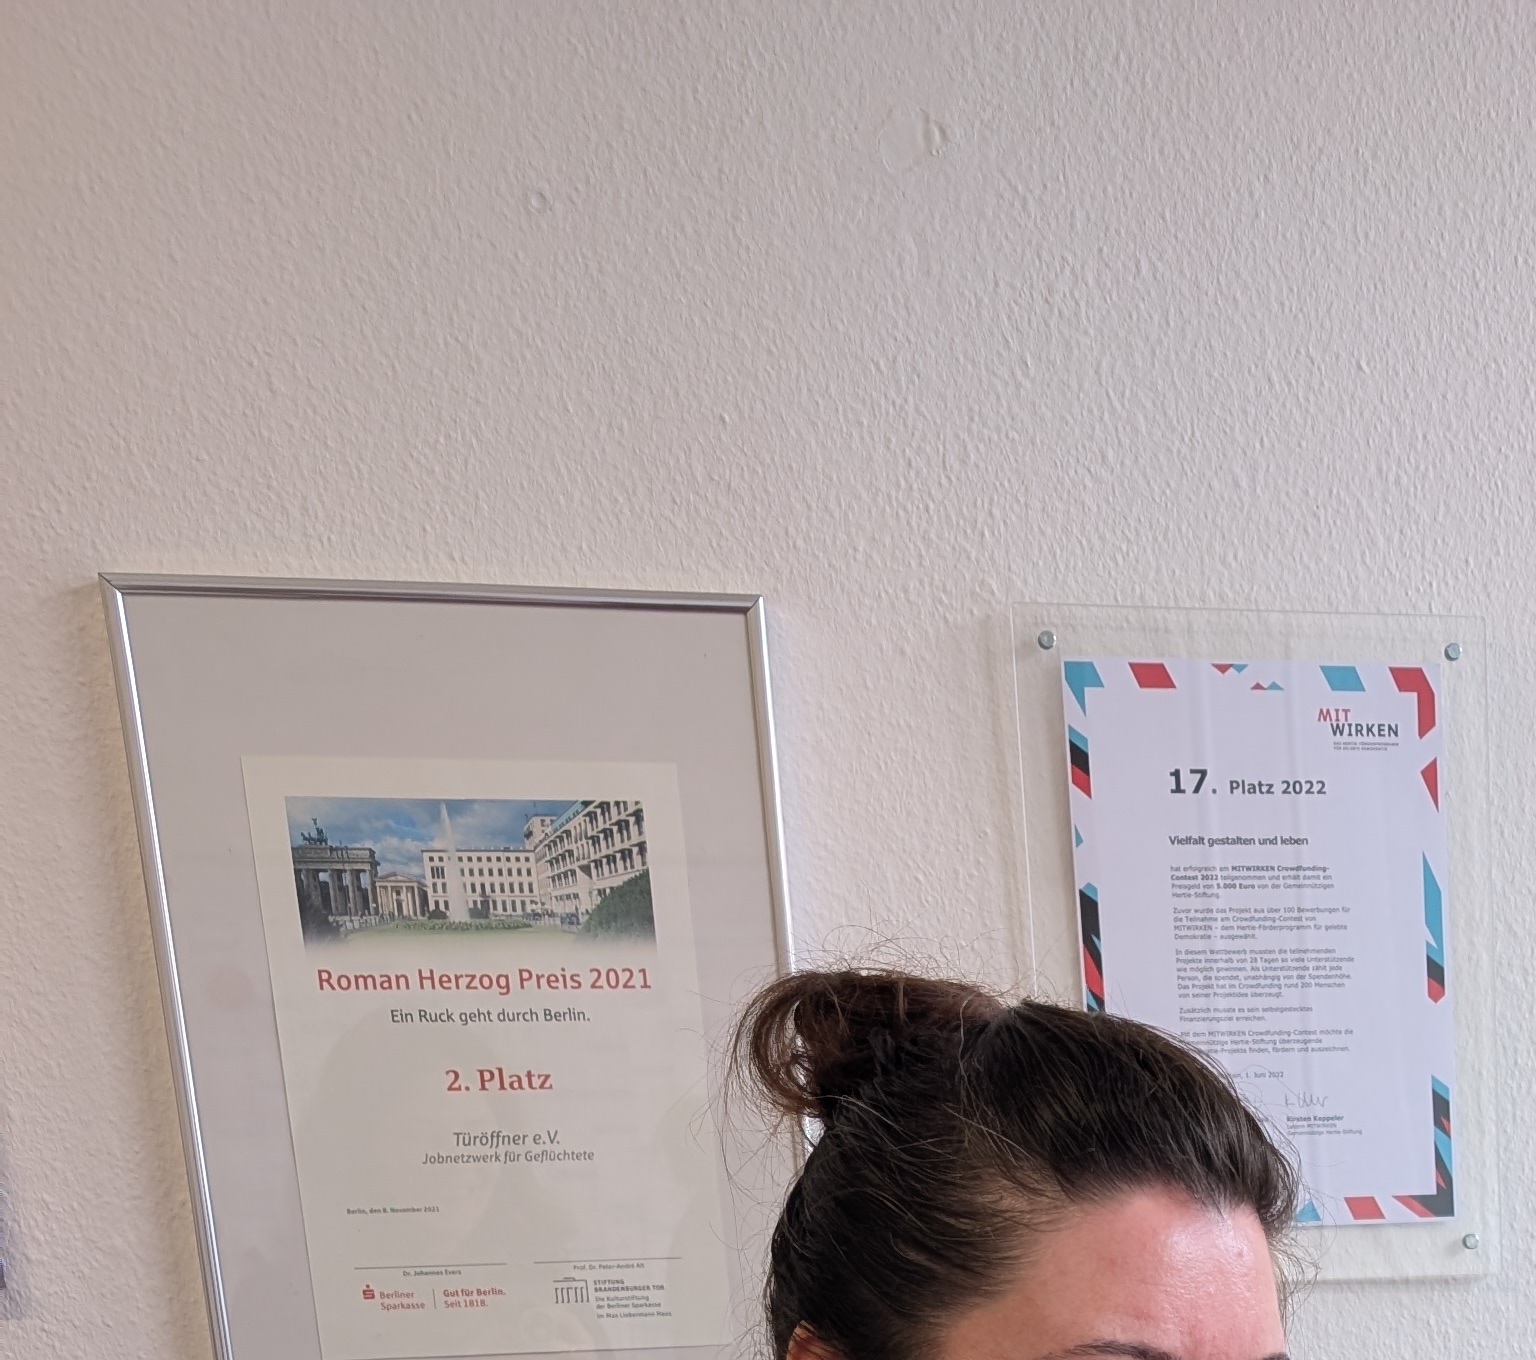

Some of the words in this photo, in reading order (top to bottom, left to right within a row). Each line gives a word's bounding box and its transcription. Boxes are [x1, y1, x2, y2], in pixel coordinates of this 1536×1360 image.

[1317, 708, 1351, 723] MIT
[1330, 723, 1399, 737] WIRKEN
[1169, 768, 1217, 794] 17.
[1229, 779, 1274, 795] Platz
[1281, 780, 1327, 795] 2022
[1169, 836, 1205, 846] Vielfalt
[1207, 836, 1255, 847] gestalten
[1258, 836, 1278, 845] und
[1280, 836, 1309, 845] leben
[317, 968, 410, 991] Roman
[418, 968, 511, 995] Herzog
[518, 967, 582, 990] Preis
[589, 967, 652, 990] 2021
[391, 1009, 414, 1023] Ein
[418, 1009, 455, 1023] Ruck
[459, 1008, 493, 1026] geht
[497, 1008, 539, 1023] durch
[543, 1007, 591, 1023] Berlin.
[445, 1069, 471, 1092] 2.
[477, 1067, 553, 1091] Platz
[453, 1130, 528, 1150] Türöffner
[532, 1129, 560, 1146] e.V.
[422, 1151, 501, 1165] Jobnetzwerk
[503, 1150, 522, 1165] für
[524, 1149, 595, 1163] Geflüchtete
[379, 1290, 414, 1299] Berliner
[443, 1289, 459, 1298] Gut
[461, 1288, 474, 1298] für
[476, 1287, 506, 1297] Berlin.
[381, 1300, 425, 1311] Sparkasse
[444, 1299, 462, 1308] Seit
[464, 1299, 488, 1308] 1818.
